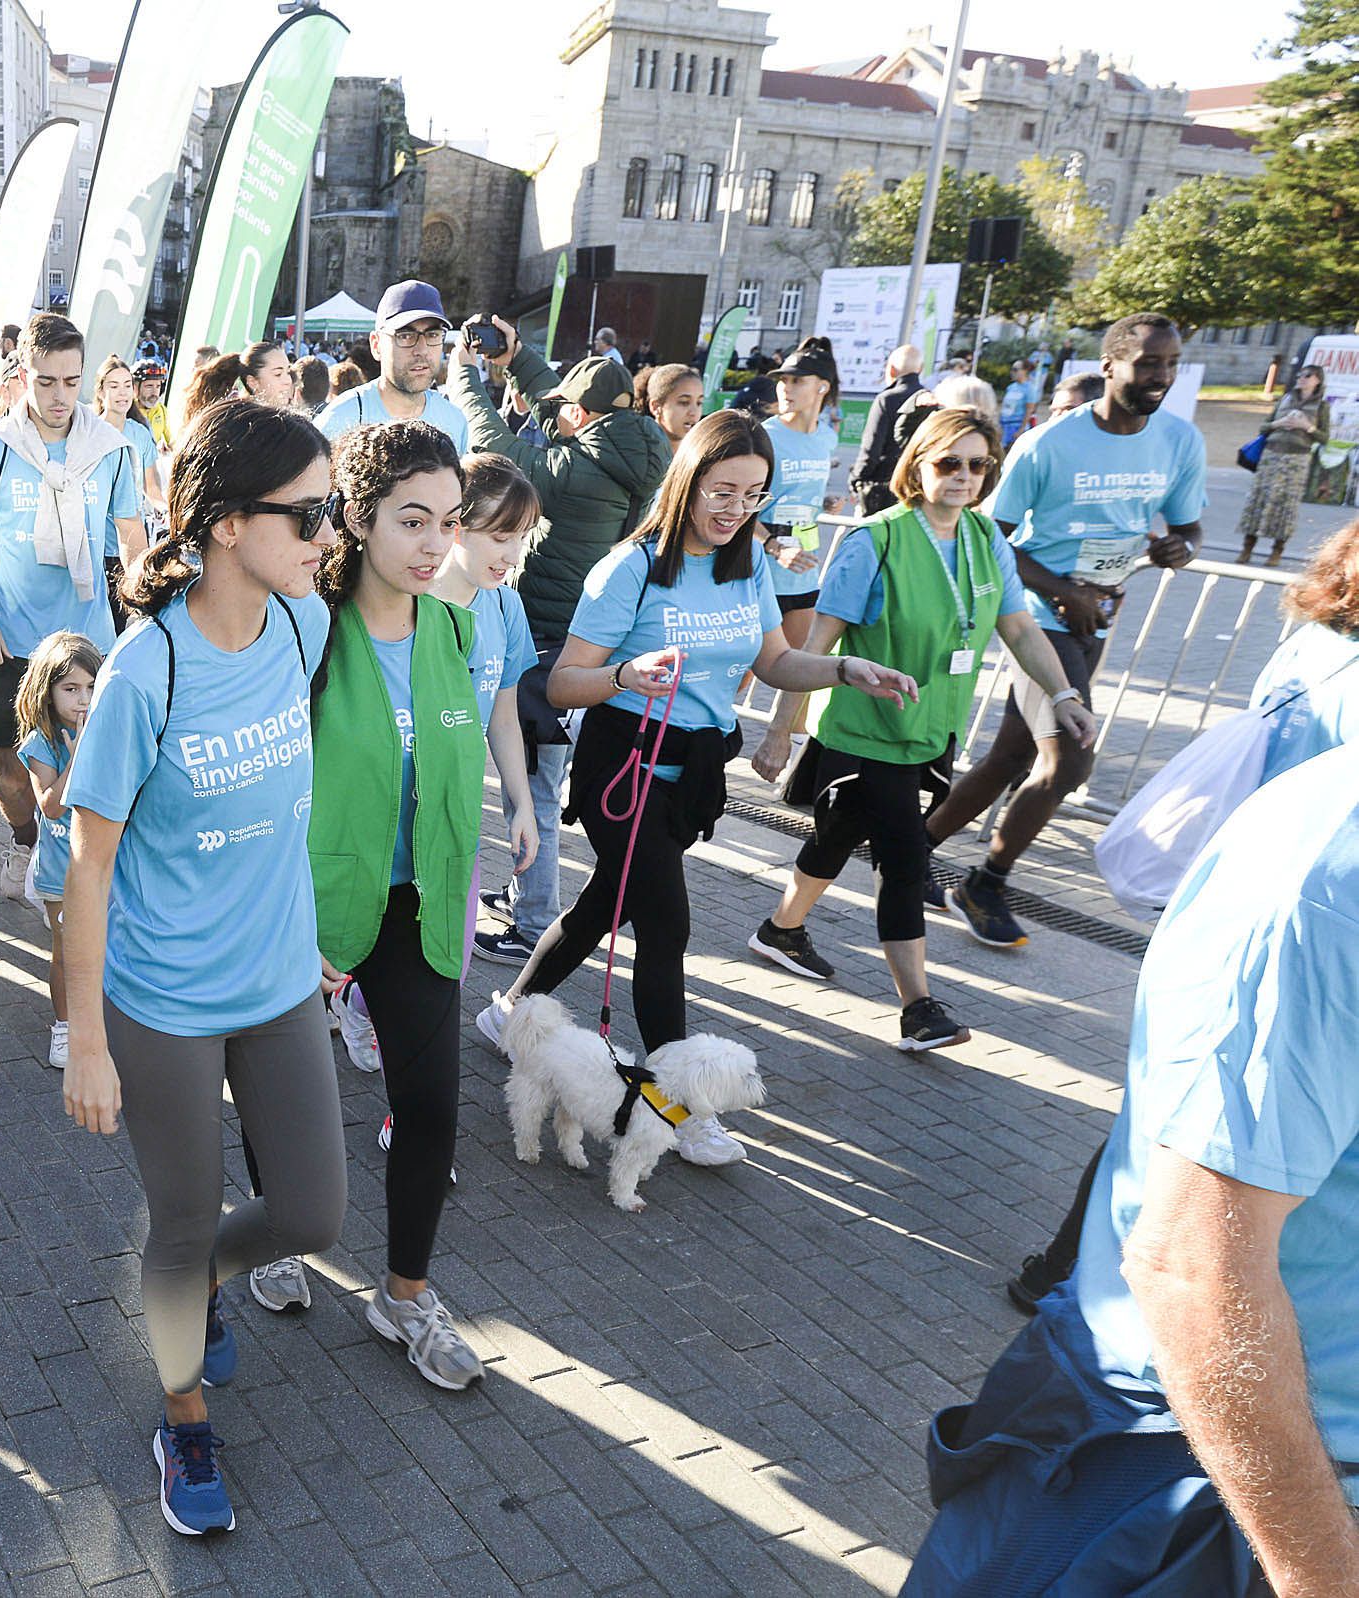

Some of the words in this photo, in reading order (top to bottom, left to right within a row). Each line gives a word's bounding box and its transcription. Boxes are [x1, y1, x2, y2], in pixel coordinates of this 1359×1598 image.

[1073, 471, 1101, 488] En
[1104, 470, 1168, 487] marcha
[663, 607, 692, 628] En
[694, 603, 760, 627] marcha
[178, 733, 230, 768] En
[190, 767, 202, 789] pola
[193, 786, 227, 798] contra
[227, 784, 235, 792] o
[235, 774, 264, 789] cancro
[228, 819, 274, 837] Deputación
[228, 827, 274, 844] Pontevedra
